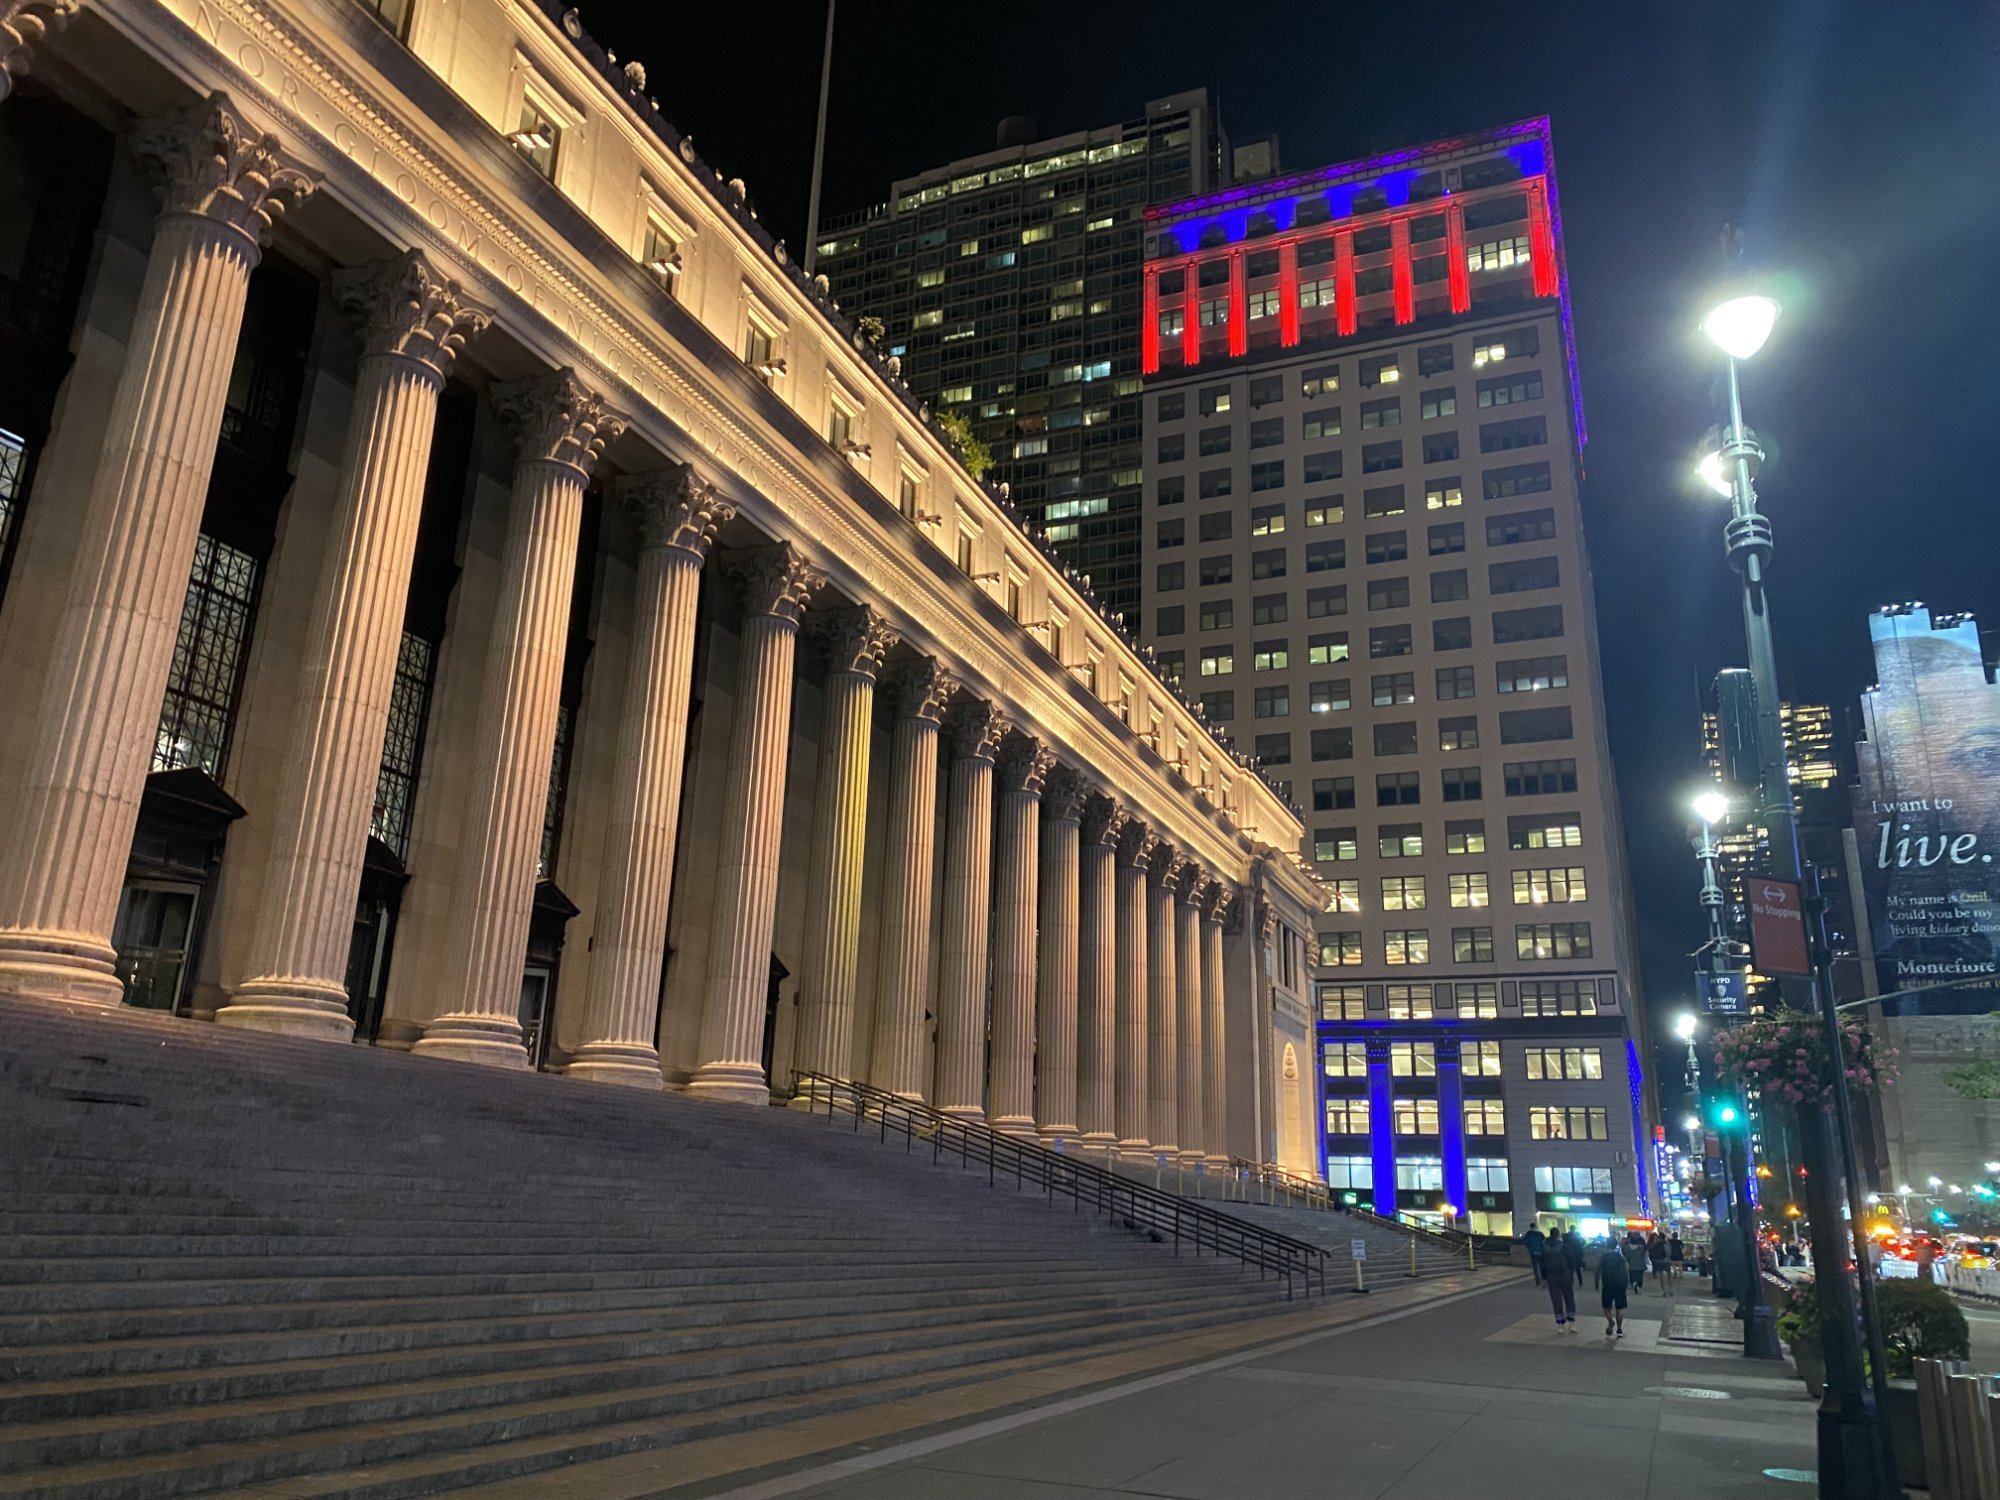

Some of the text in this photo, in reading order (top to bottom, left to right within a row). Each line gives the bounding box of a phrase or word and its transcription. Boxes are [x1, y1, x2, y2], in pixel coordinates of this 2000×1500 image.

[194, 4, 305, 106] NOR
[334, 122, 482, 260] GLOOM
[505, 264, 546, 307] OF
[567, 310, 667, 407] NIGHT
[684, 409, 758, 488] STAYS
[1871, 798, 1953, 814] I want to
[1877, 821, 1992, 869] live.
[1887, 895, 1907, 908] My
[1909, 896, 1945, 906] name
[1765, 904, 1801, 921] Stopping
[1889, 907, 1993, 922] Could you be my
[1890, 923, 1927, 937] living
[1929, 922, 1970, 936] kidney
[1707, 996, 1737, 1004] Security
